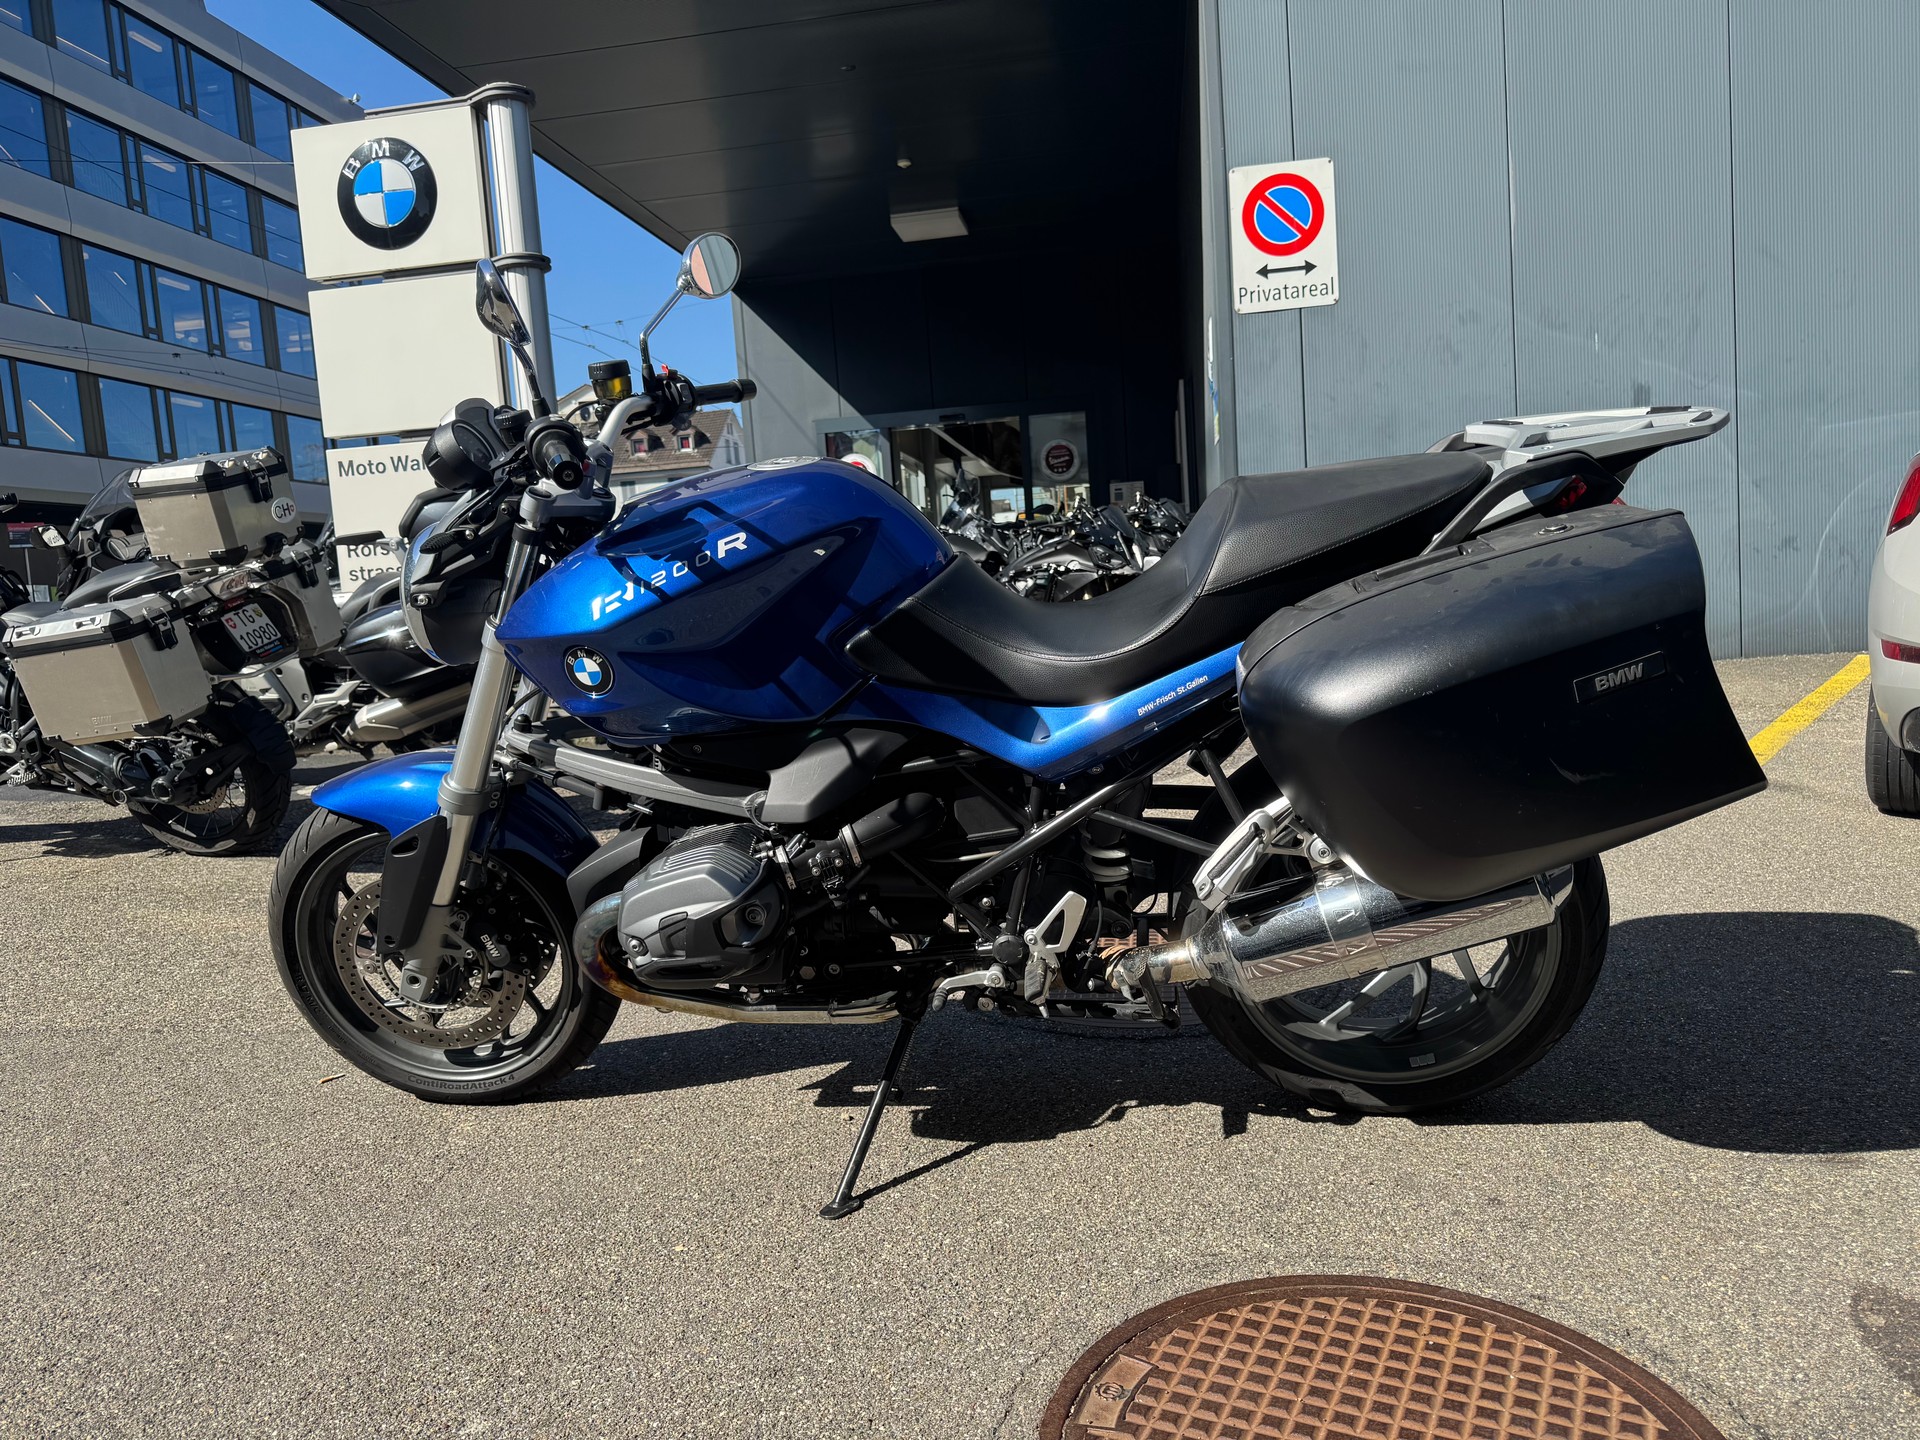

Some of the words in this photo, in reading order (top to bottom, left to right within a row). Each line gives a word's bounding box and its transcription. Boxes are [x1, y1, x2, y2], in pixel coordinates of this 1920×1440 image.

[342, 139, 425, 179] BMW
[1239, 276, 1335, 305] Privatareal
[338, 459, 387, 477] Moto
[274, 502, 292, 519] CH
[717, 531, 748, 559] R
[233, 608, 255, 627] TG
[239, 622, 278, 650] 10980
[567, 650, 603, 666] BMW
[1594, 662, 1644, 692] BMW
[1137, 692, 1176, 716] BMW-Frisch
[1177, 675, 1208, 695] St.Gallen
[480, 934, 501, 957] BMW
[407, 1074, 507, 1090] ContiRoadAttack
